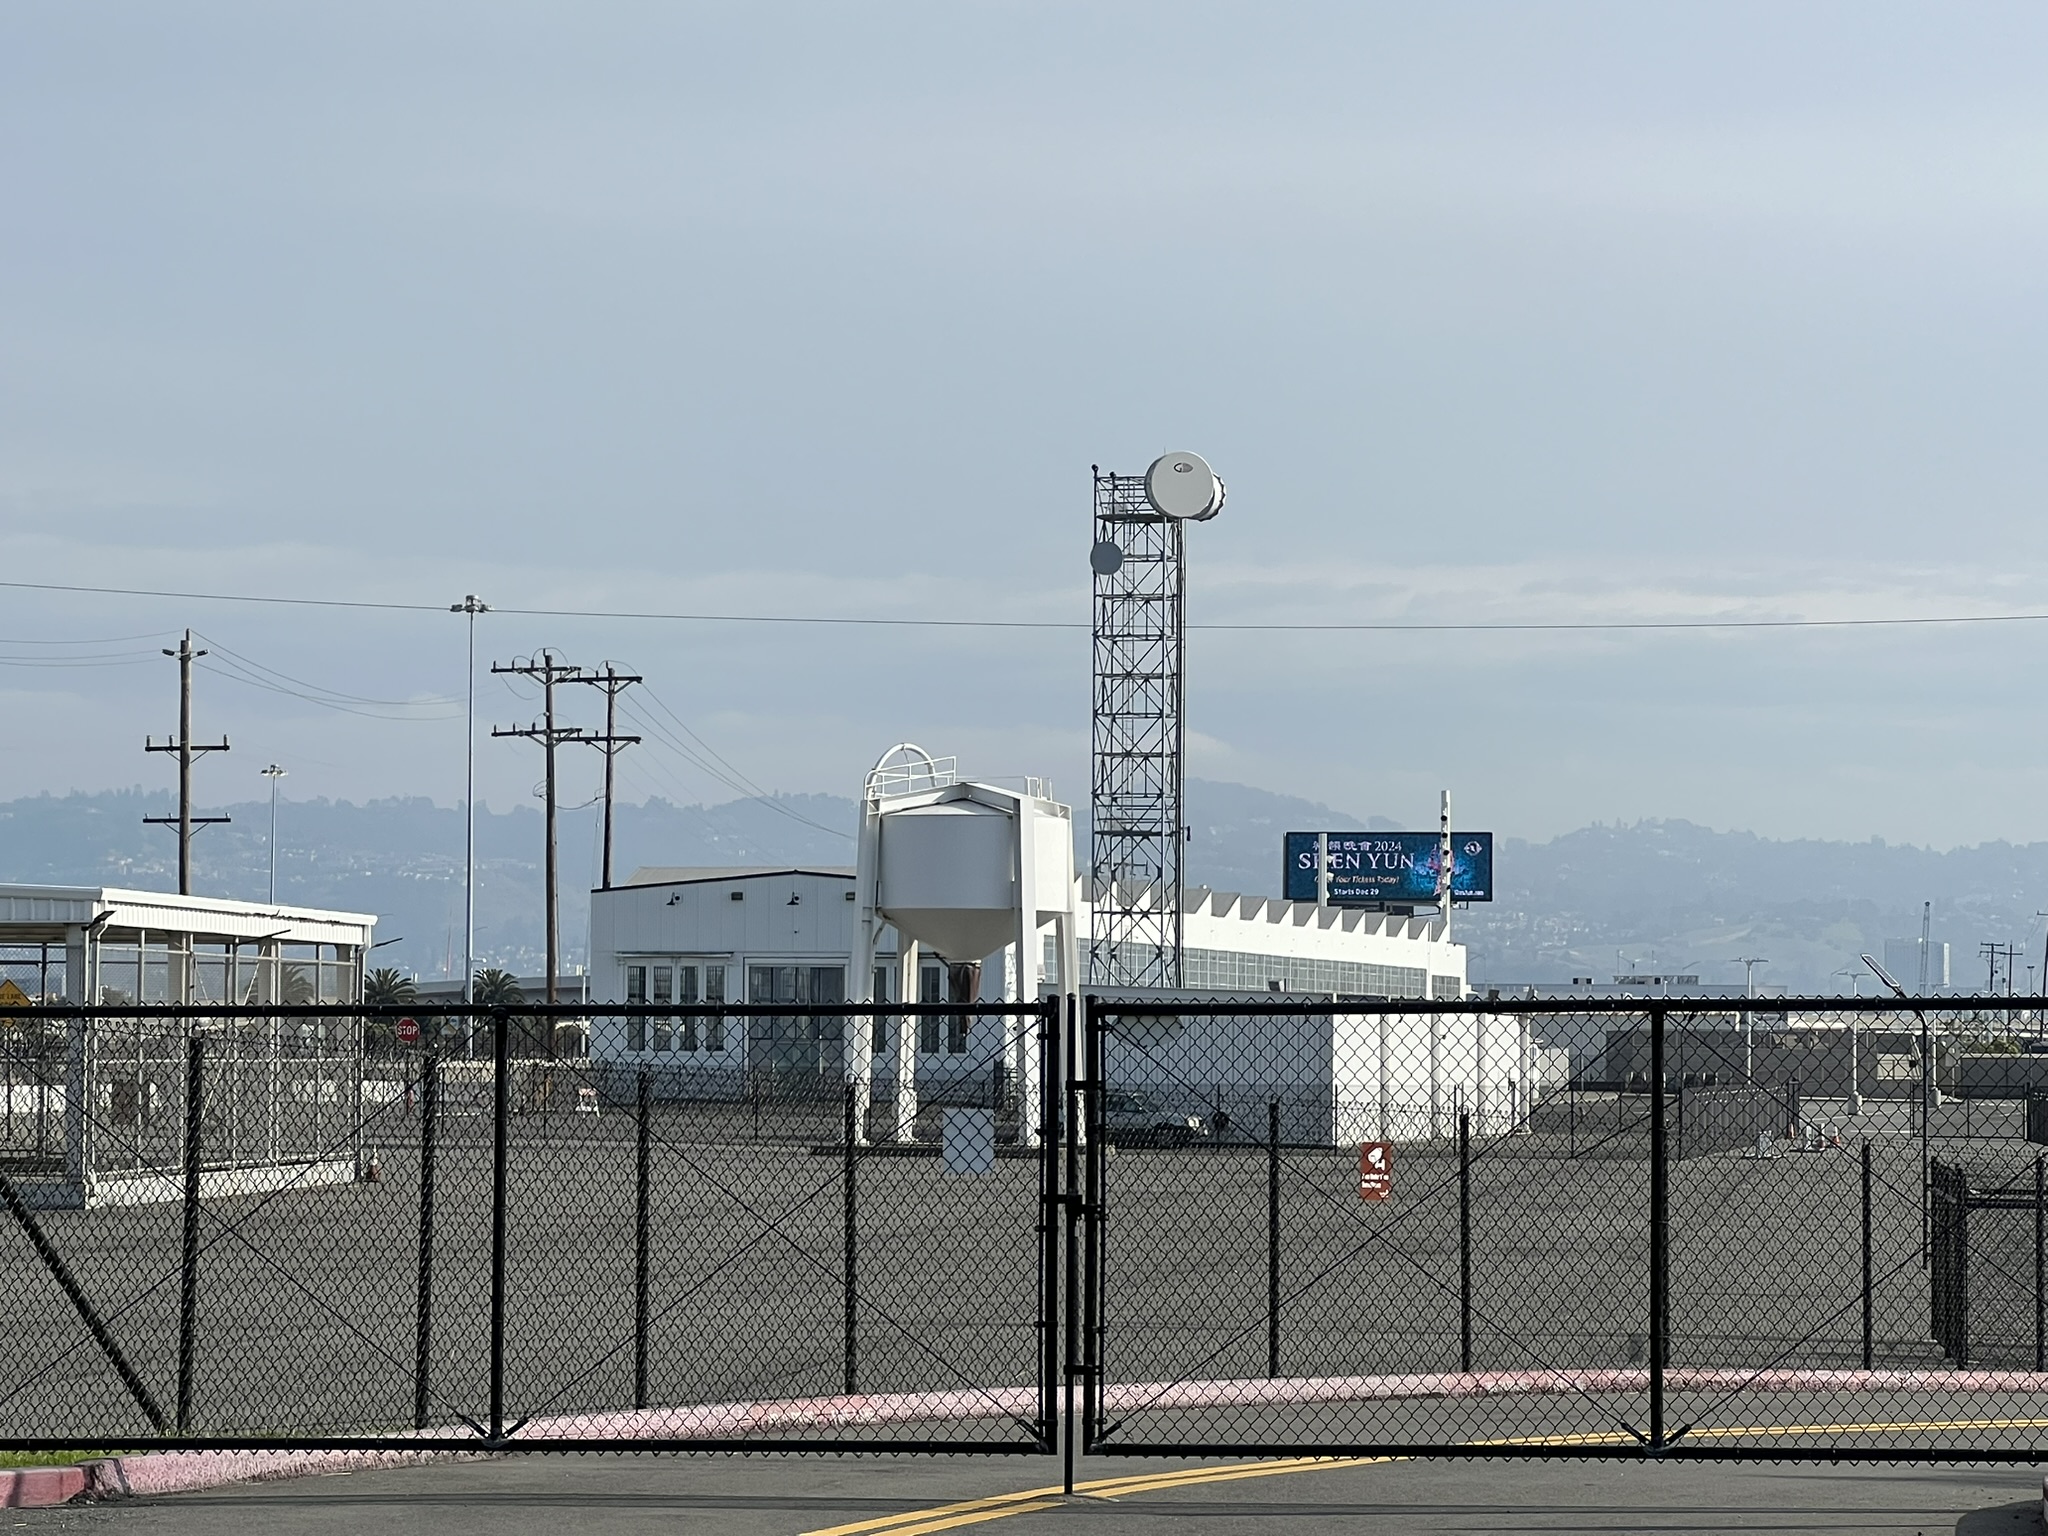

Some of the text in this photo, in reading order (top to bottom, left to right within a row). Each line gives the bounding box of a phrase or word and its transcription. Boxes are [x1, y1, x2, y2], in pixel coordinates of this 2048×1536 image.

[1374, 840, 1402, 852] 2024
[1366, 852, 1415, 870] YUN
[1333, 888, 1355, 896] Starts
[1370, 888, 1380, 896] 29
[397, 1025, 418, 1035] STOP
